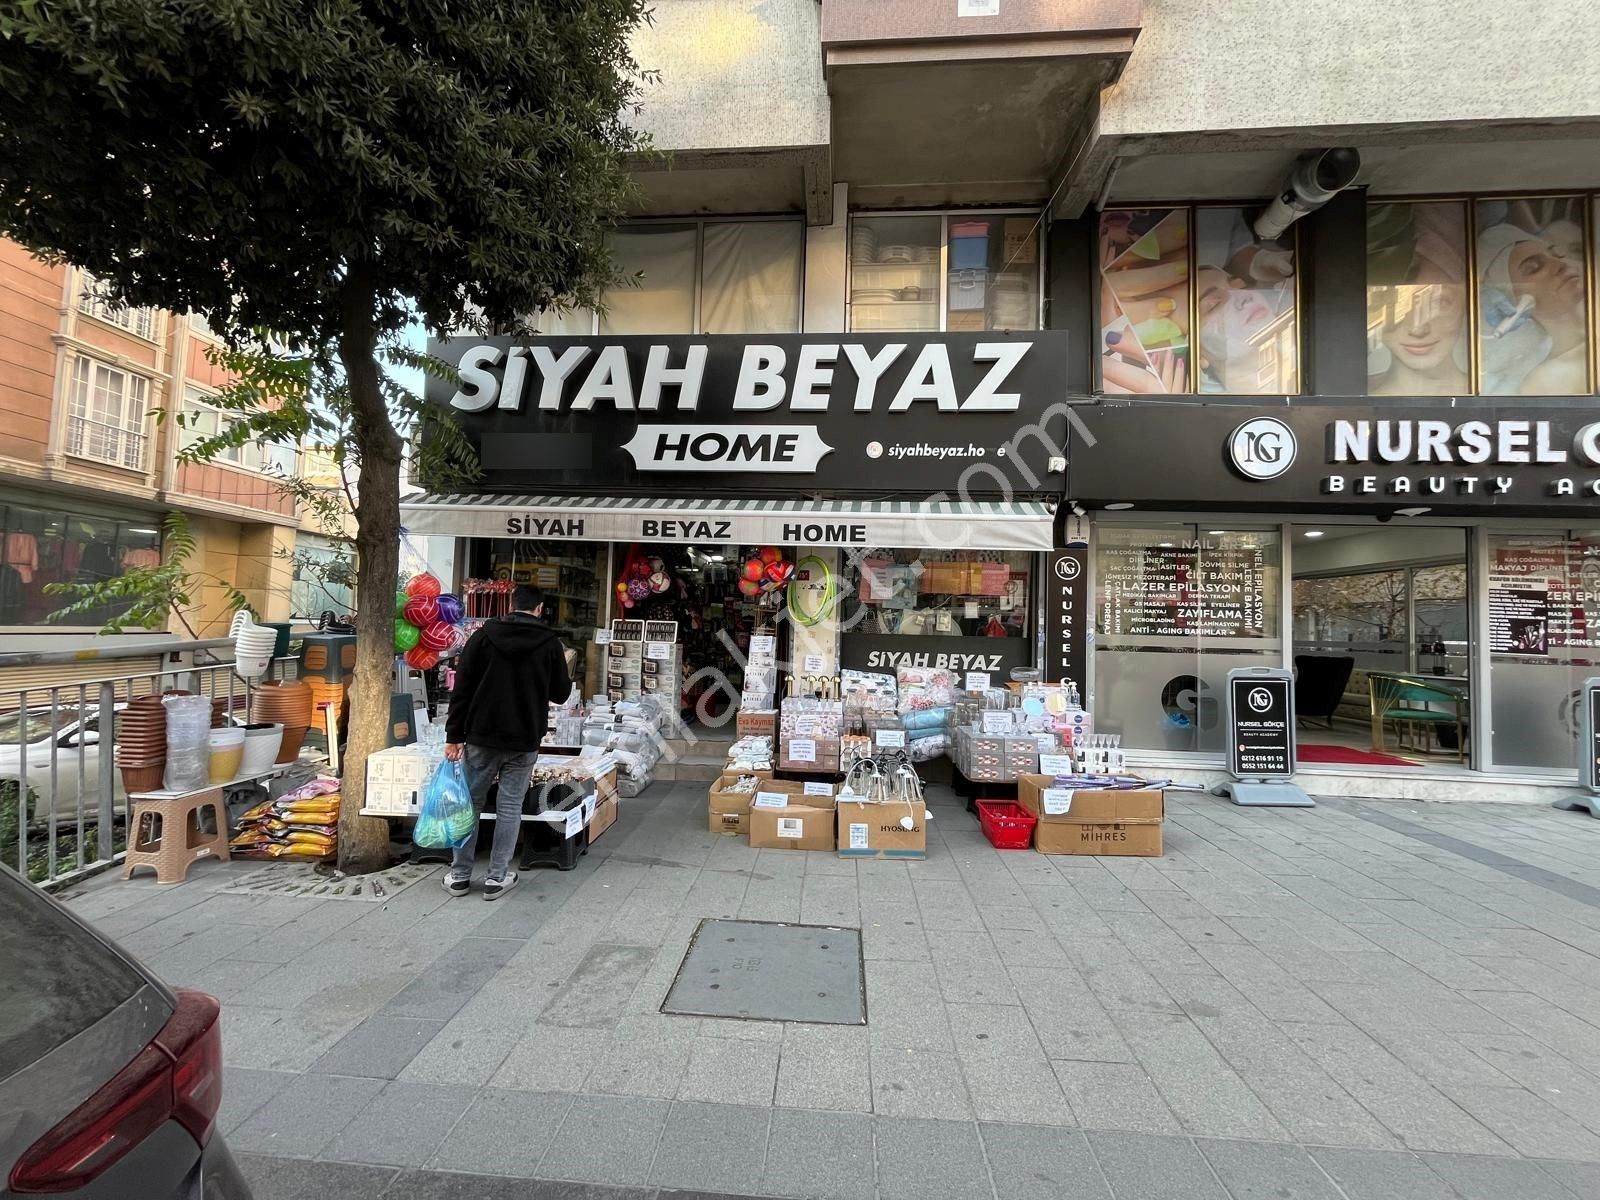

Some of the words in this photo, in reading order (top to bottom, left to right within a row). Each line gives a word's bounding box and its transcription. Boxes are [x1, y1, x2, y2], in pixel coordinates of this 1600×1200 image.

[732, 342, 1034, 413] BEYAZ
[653, 432, 799, 462] HOME
[888, 443, 1006, 460] siyahbeyaz.hoe
[1333, 419, 1567, 464] NURSEL
[1327, 475, 1513, 494] BEAUTY
[506, 514, 584, 537] SİYAH
[642, 519, 731, 539] BEYAZ
[783, 523, 866, 542] HOME
[1160, 563, 1190, 571] ASİTLER
[1210, 571, 1242, 581] BAKIM
[1122, 582, 1165, 592] LAZER
[1169, 581, 1241, 593] EPİLASYON
[1244, 569, 1253, 593] LEKE
[1244, 595, 1253, 629] BAKIMI
[1254, 573, 1264, 628] EPİLASYON
[1104, 602, 1112, 635] DRENAJ
[1177, 608, 1243, 619] ZAYIFLAMA
[1061, 586, 1073, 668] NURSEL
[1130, 626, 1149, 634] ANTİ
[1184, 627, 1227, 636] BAKIMLAR
[934, 653, 1004, 671] BEYAZ
